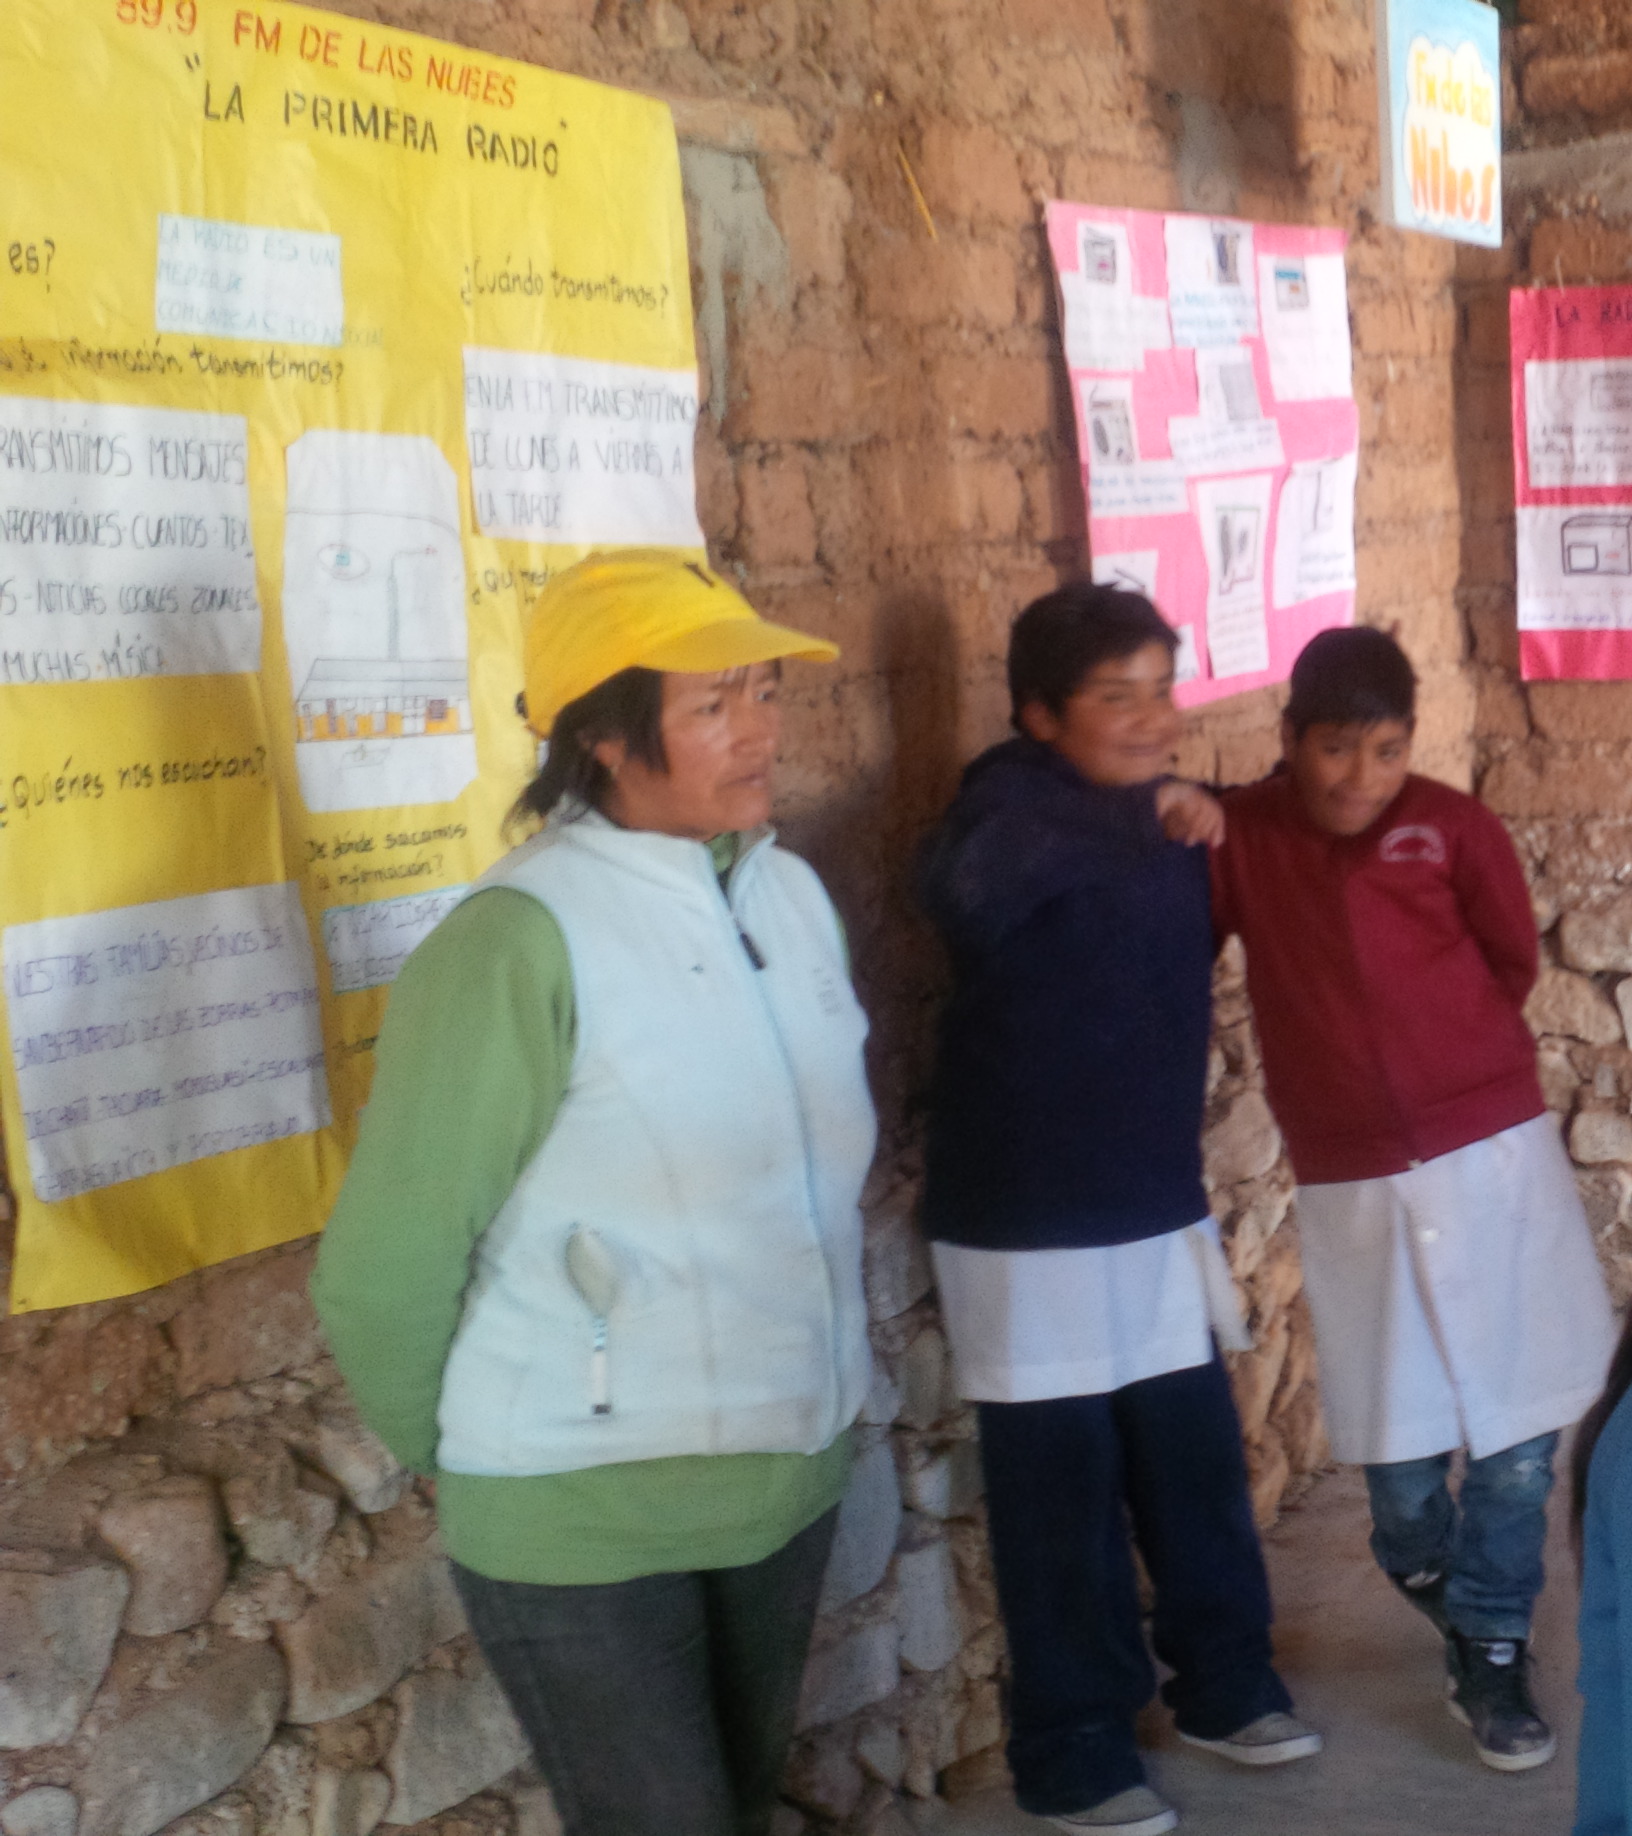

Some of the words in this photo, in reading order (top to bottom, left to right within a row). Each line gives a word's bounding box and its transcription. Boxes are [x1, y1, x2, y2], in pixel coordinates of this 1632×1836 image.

[233, 9, 282, 56] FM
[299, 23, 342, 68] DE
[357, 37, 414, 83] LAS
[426, 54, 517, 110] NUBES
[283, 88, 438, 154] PRIMERA
[8, 236, 56, 294] es?
